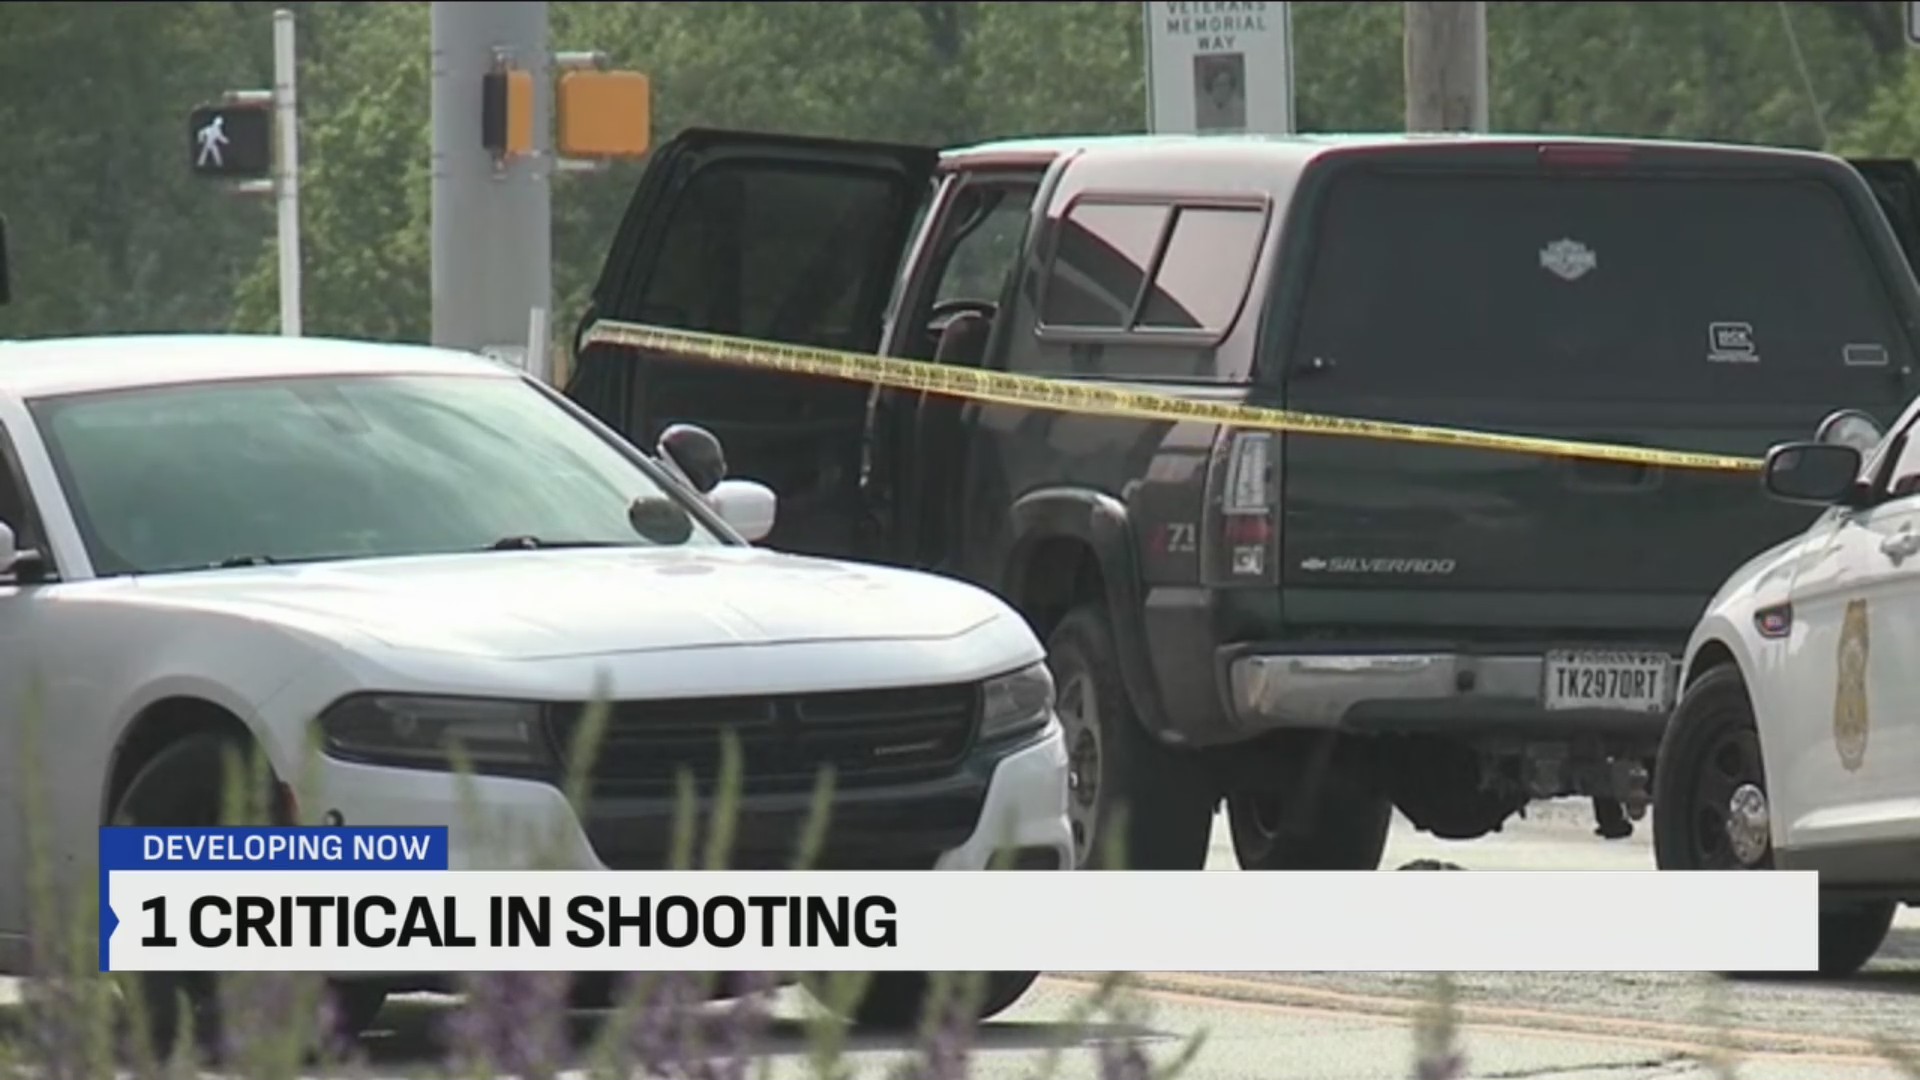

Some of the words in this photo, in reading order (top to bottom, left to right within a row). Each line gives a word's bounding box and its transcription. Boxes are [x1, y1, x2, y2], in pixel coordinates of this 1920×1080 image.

[1167, 2, 1266, 14] VETERANS
[1167, 16, 1266, 33] MEMORIAL
[1198, 36, 1236, 49] WAY
[1328, 557, 1456, 573] SILVERADO
